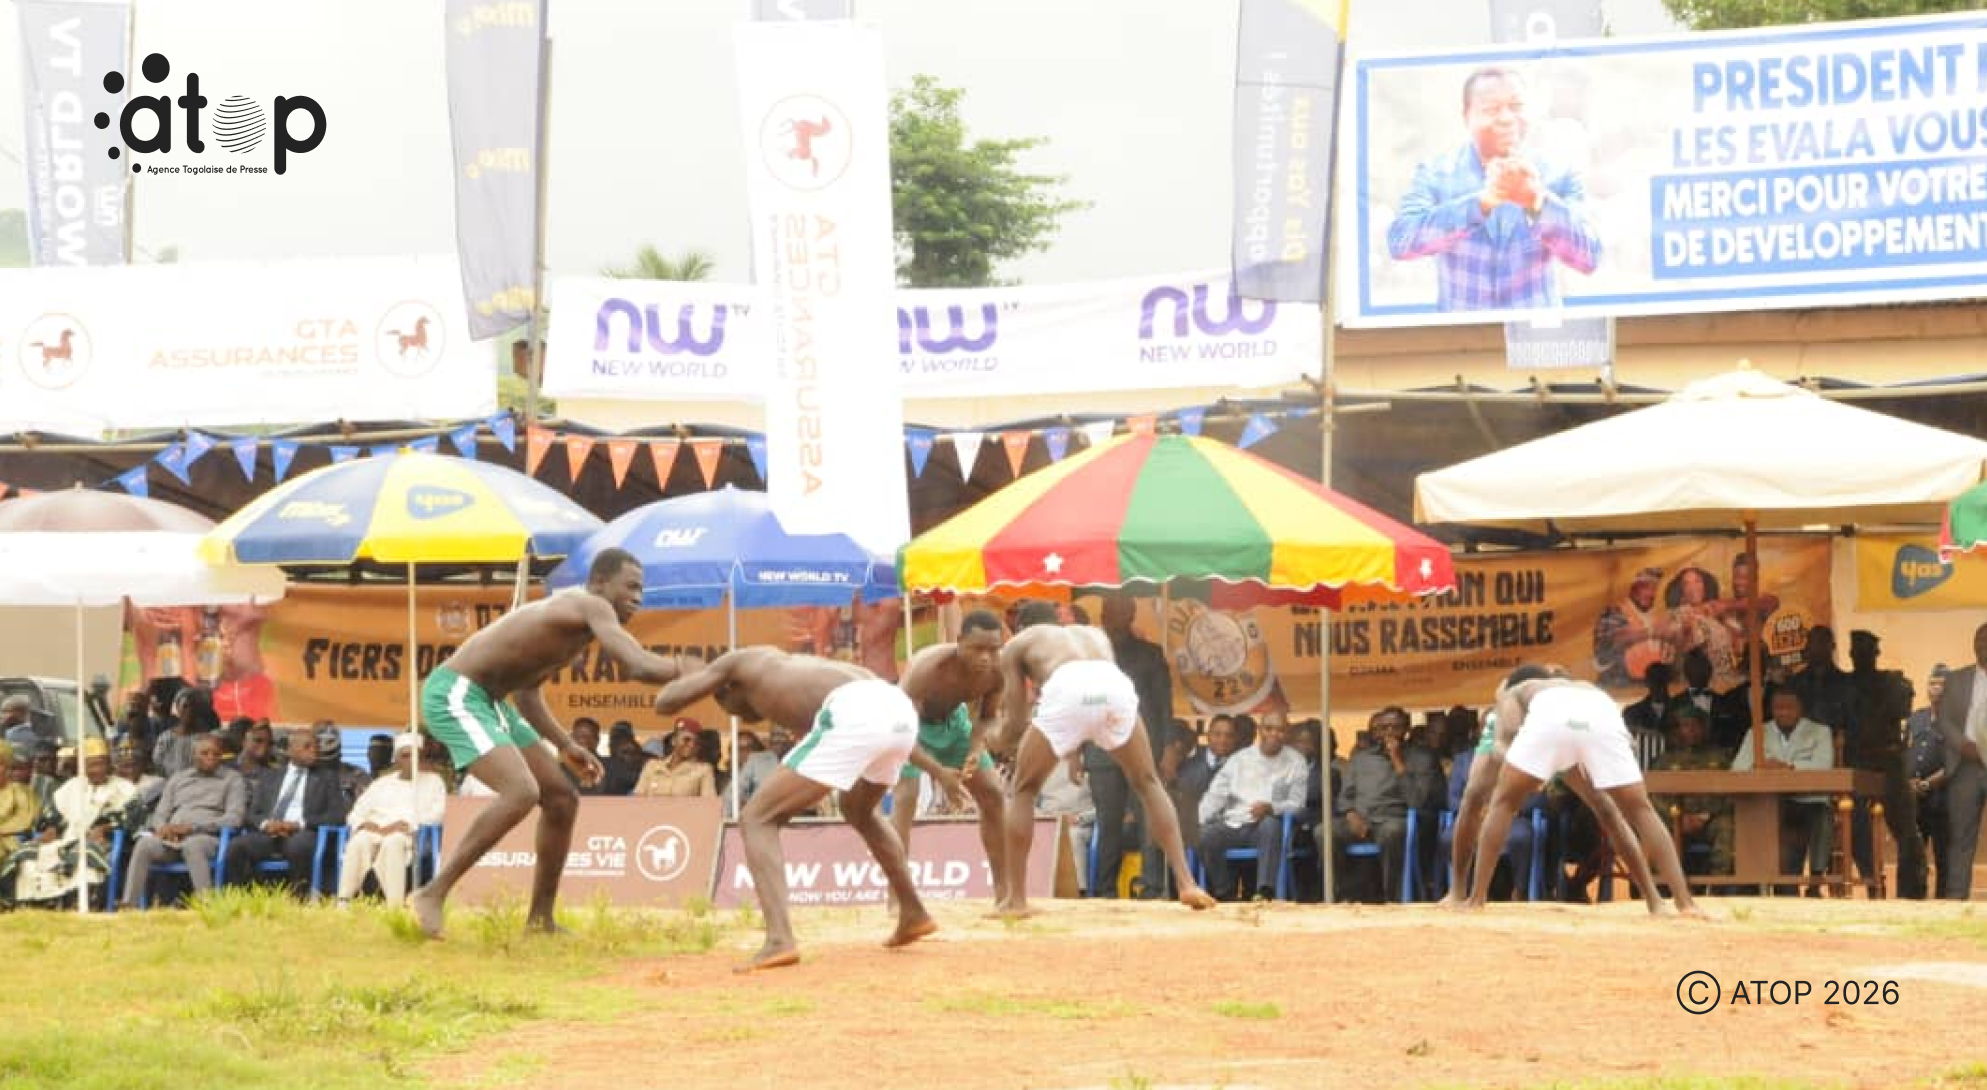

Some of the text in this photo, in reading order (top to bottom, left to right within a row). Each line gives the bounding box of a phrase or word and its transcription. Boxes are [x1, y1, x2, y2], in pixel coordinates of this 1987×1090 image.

[1692, 43, 1965, 113] PRESIDENT
[1672, 124, 1737, 168] LES
[1748, 115, 1875, 164] EVALA
[1663, 164, 1987, 220] MERCI POUR VOTRE
[1664, 229, 1706, 268] DE
[297, 320, 358, 339] GTA
[148, 344, 358, 369] ASSURANCES
[1139, 340, 1278, 363] NEW WORLD
[592, 359, 728, 379] NEW WORLD
[758, 571, 850, 583] NEW WORLD TV
[1495, 569, 1545, 605] QUI
[1380, 610, 1555, 655] RASSEMBLE
[303, 638, 403, 680] FIERS
[588, 836, 626, 851] GTA
[597, 851, 626, 868] VIE
[734, 862, 822, 889] NW
